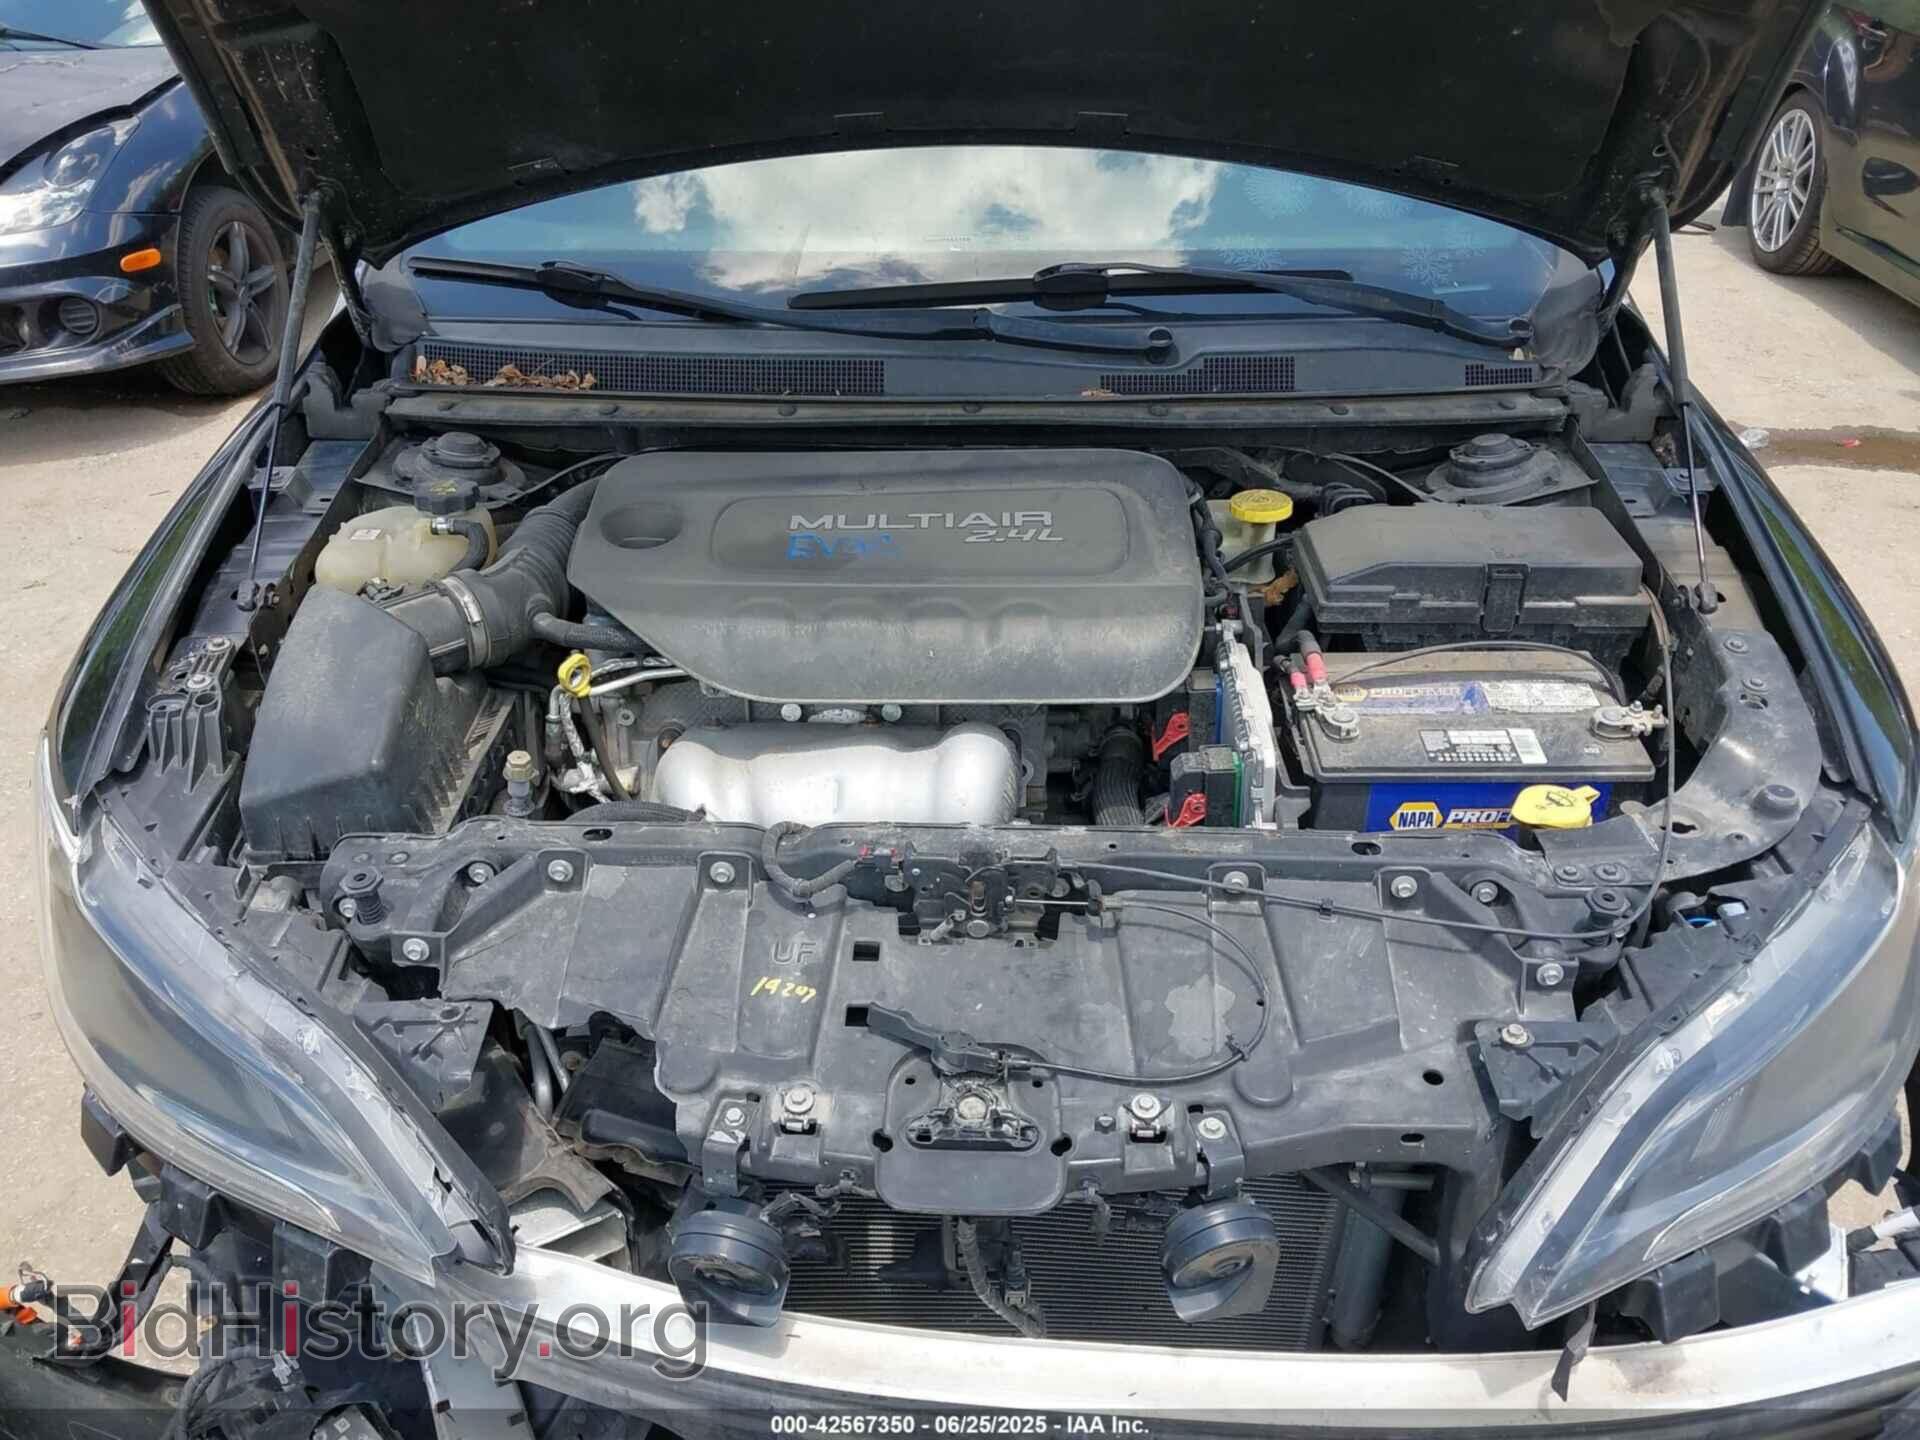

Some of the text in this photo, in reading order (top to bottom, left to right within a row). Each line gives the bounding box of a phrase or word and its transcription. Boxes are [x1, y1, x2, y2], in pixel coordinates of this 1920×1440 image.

[789, 511, 1053, 530] MULTIAIR
[964, 528, 1064, 543] 2.4L
[1398, 811, 1435, 828] NAPA
[771, 941, 817, 964] UF
